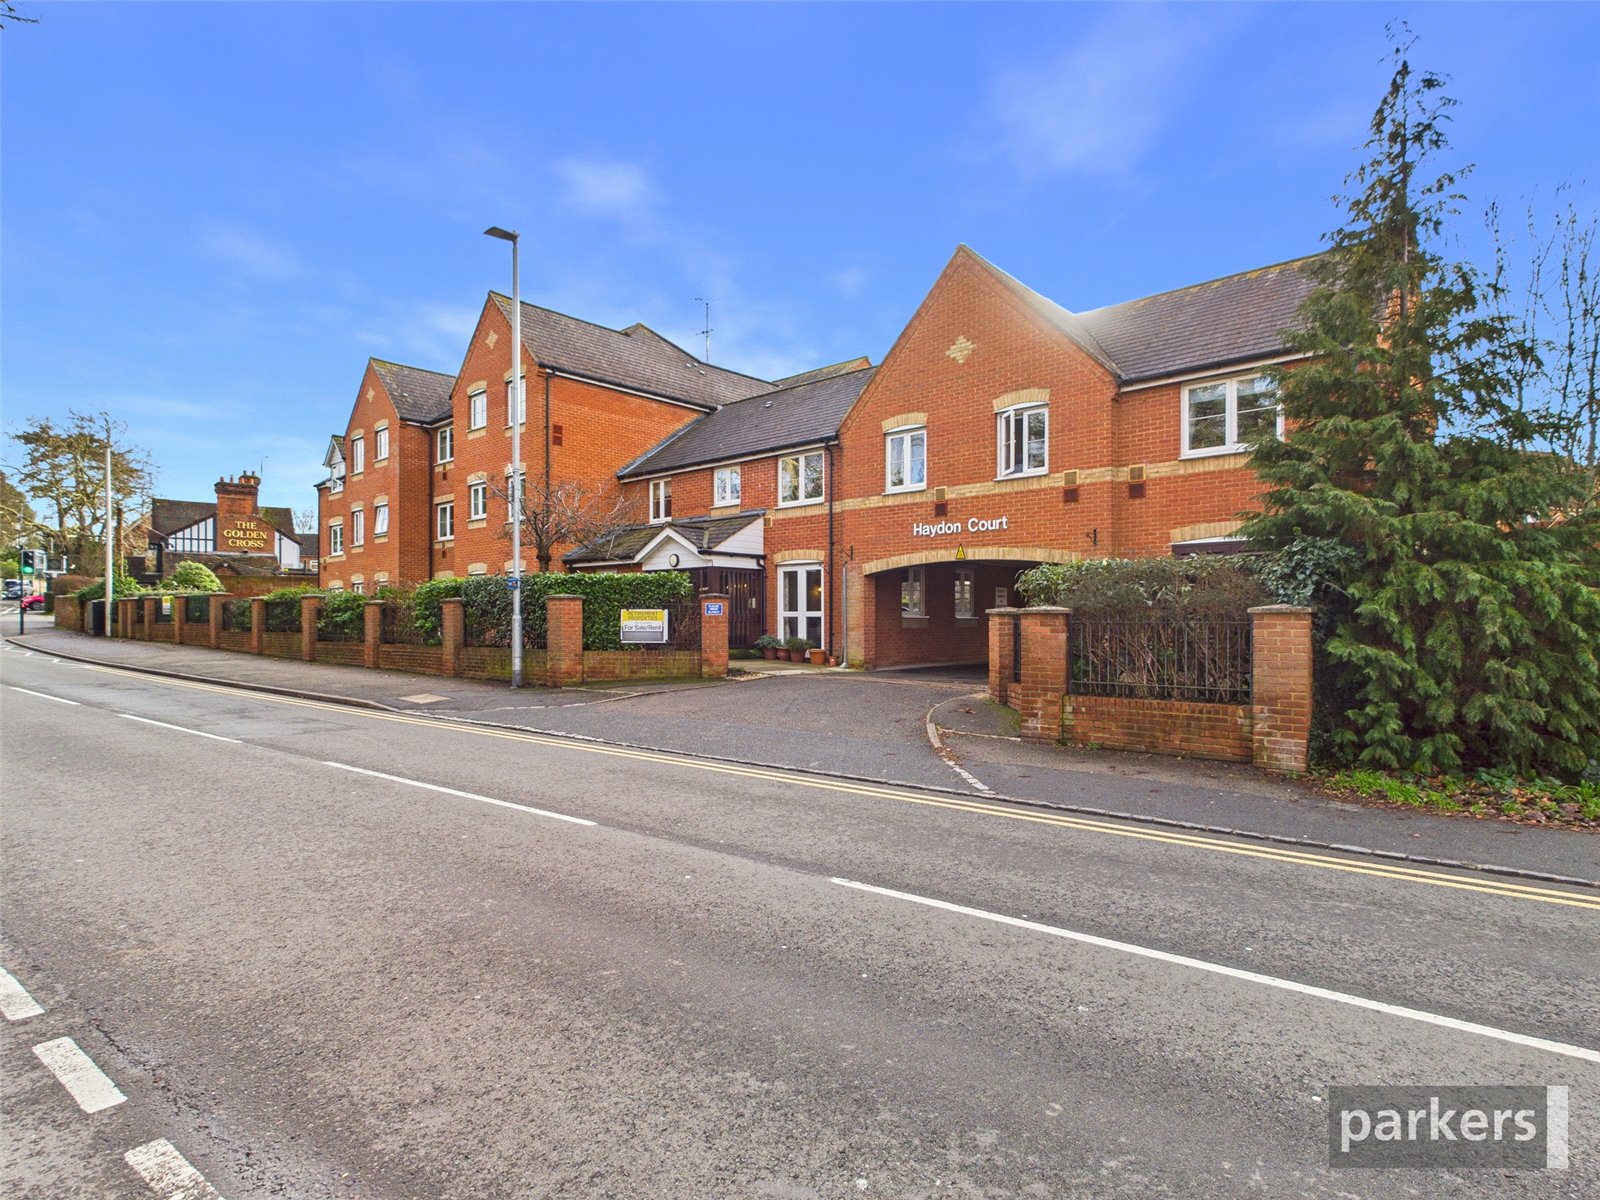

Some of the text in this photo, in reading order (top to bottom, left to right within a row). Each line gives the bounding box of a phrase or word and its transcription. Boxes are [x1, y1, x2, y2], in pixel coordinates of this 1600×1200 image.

[235, 521, 257, 529] THE
[913, 516, 1008, 537] Haydon Court
[223, 529, 267, 539] GOLDEN
[228, 539, 264, 547] CROSS
